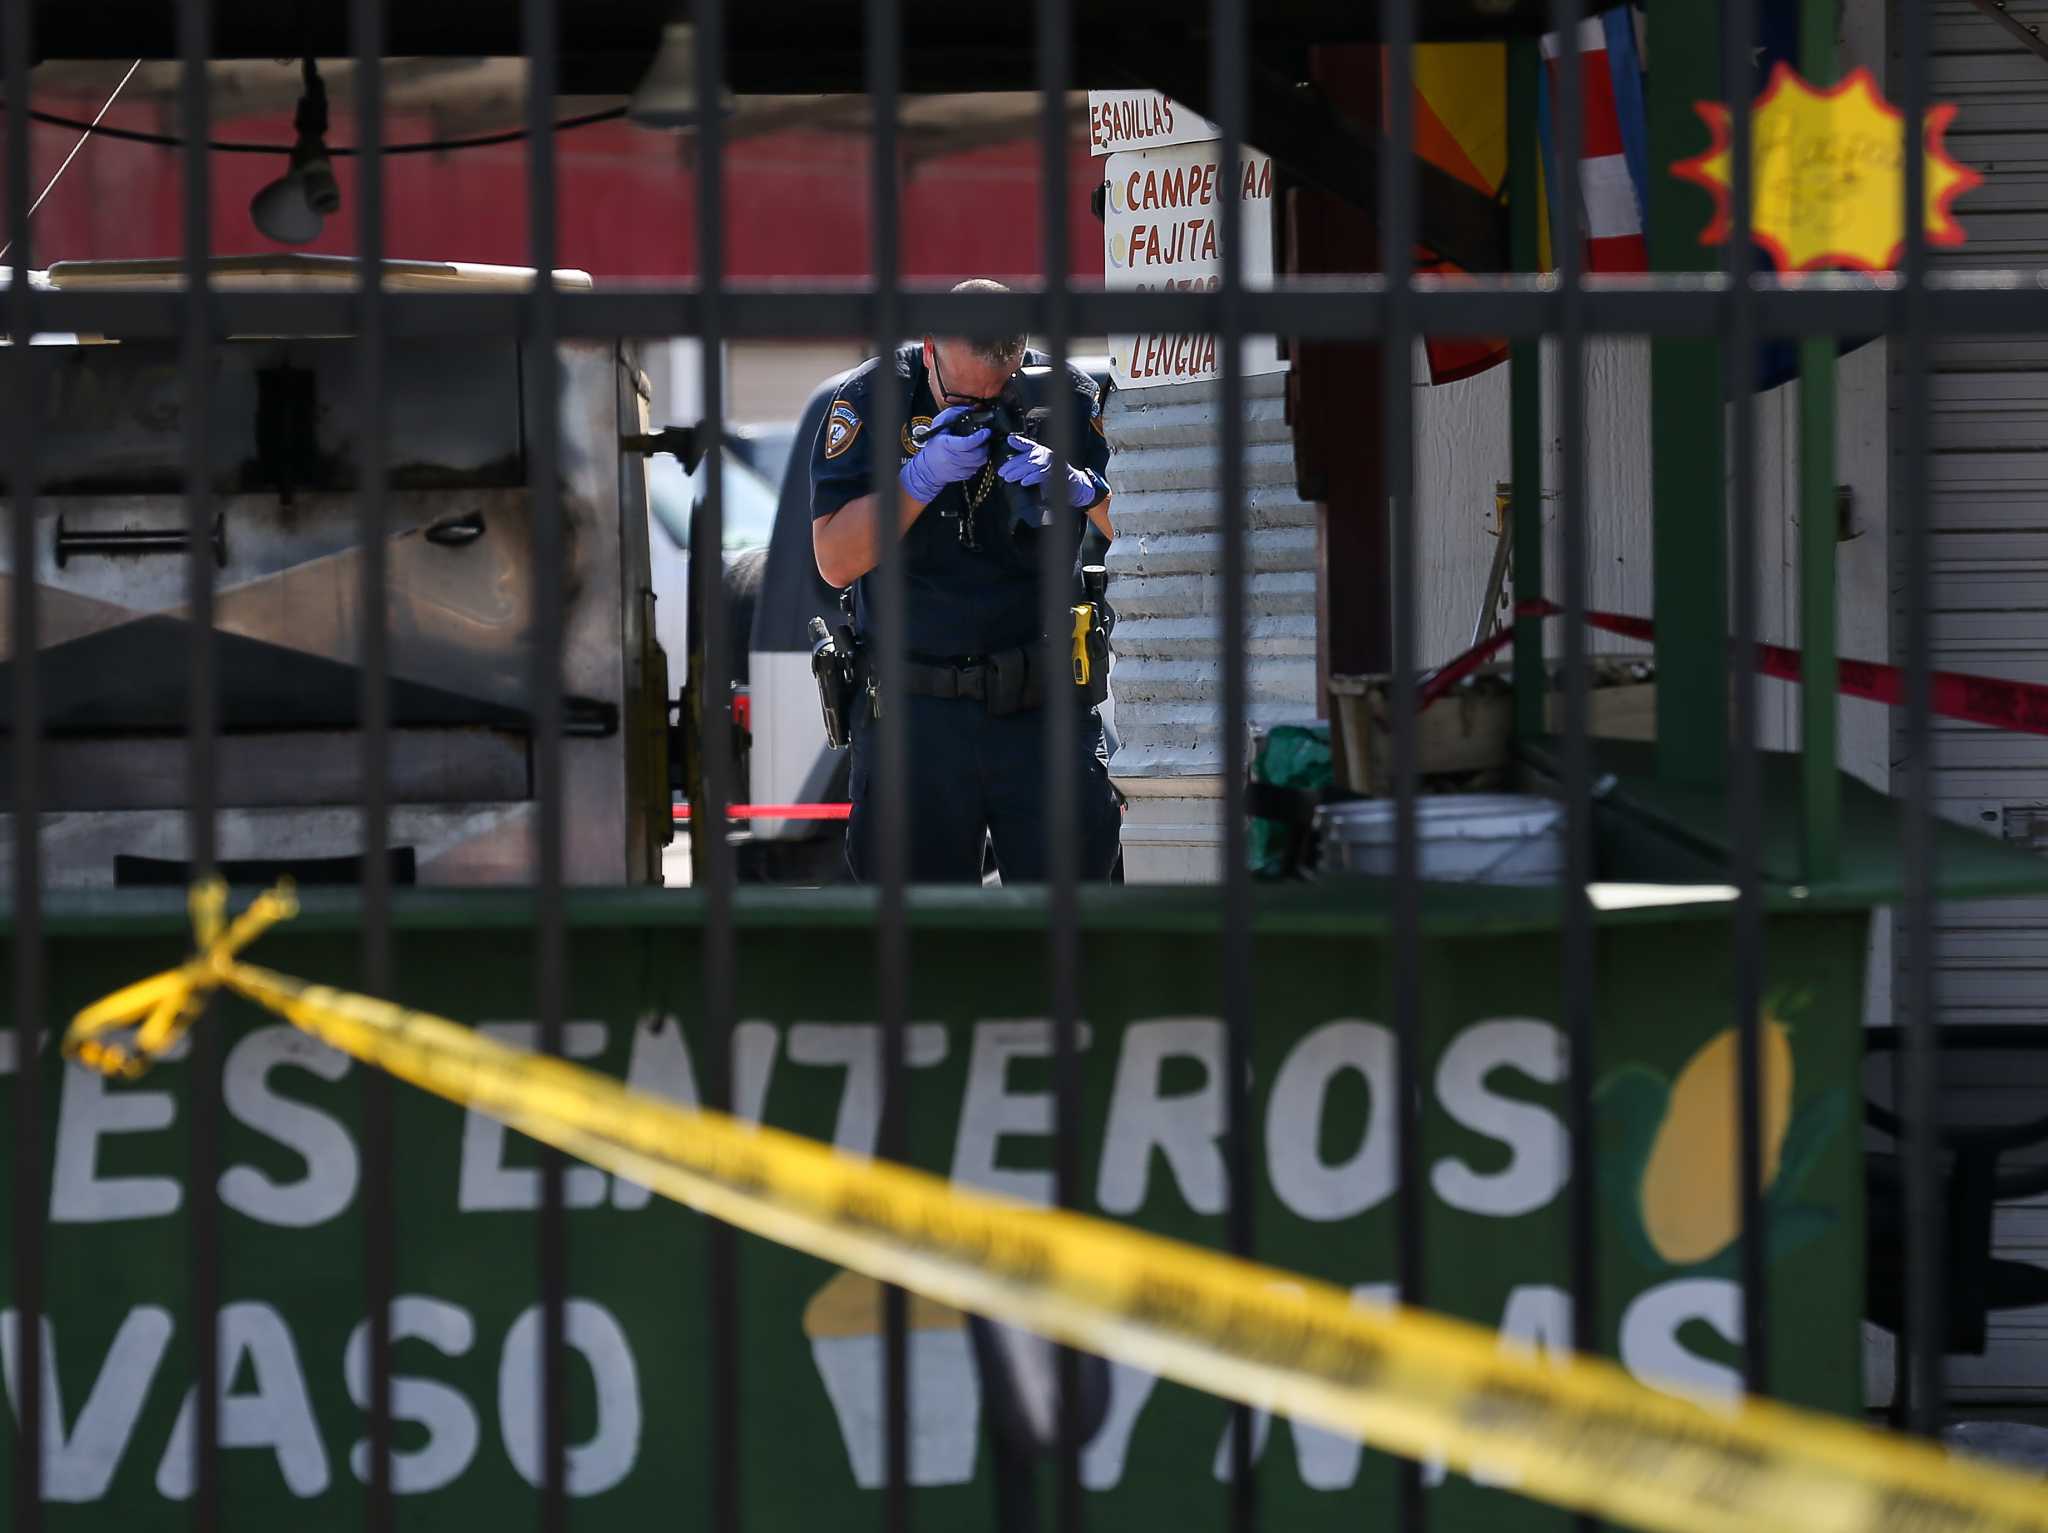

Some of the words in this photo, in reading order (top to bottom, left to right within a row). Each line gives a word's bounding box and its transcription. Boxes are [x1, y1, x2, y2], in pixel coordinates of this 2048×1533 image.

[1091, 96, 1174, 146] ESADILLAS
[1126, 158, 1272, 212] CAMPEAN
[1128, 219, 1226, 268] FAJITA
[1130, 334, 1217, 379] LENGUA
[0, 1025, 360, 1228] ES
[0, 1295, 642, 1500] VASO
